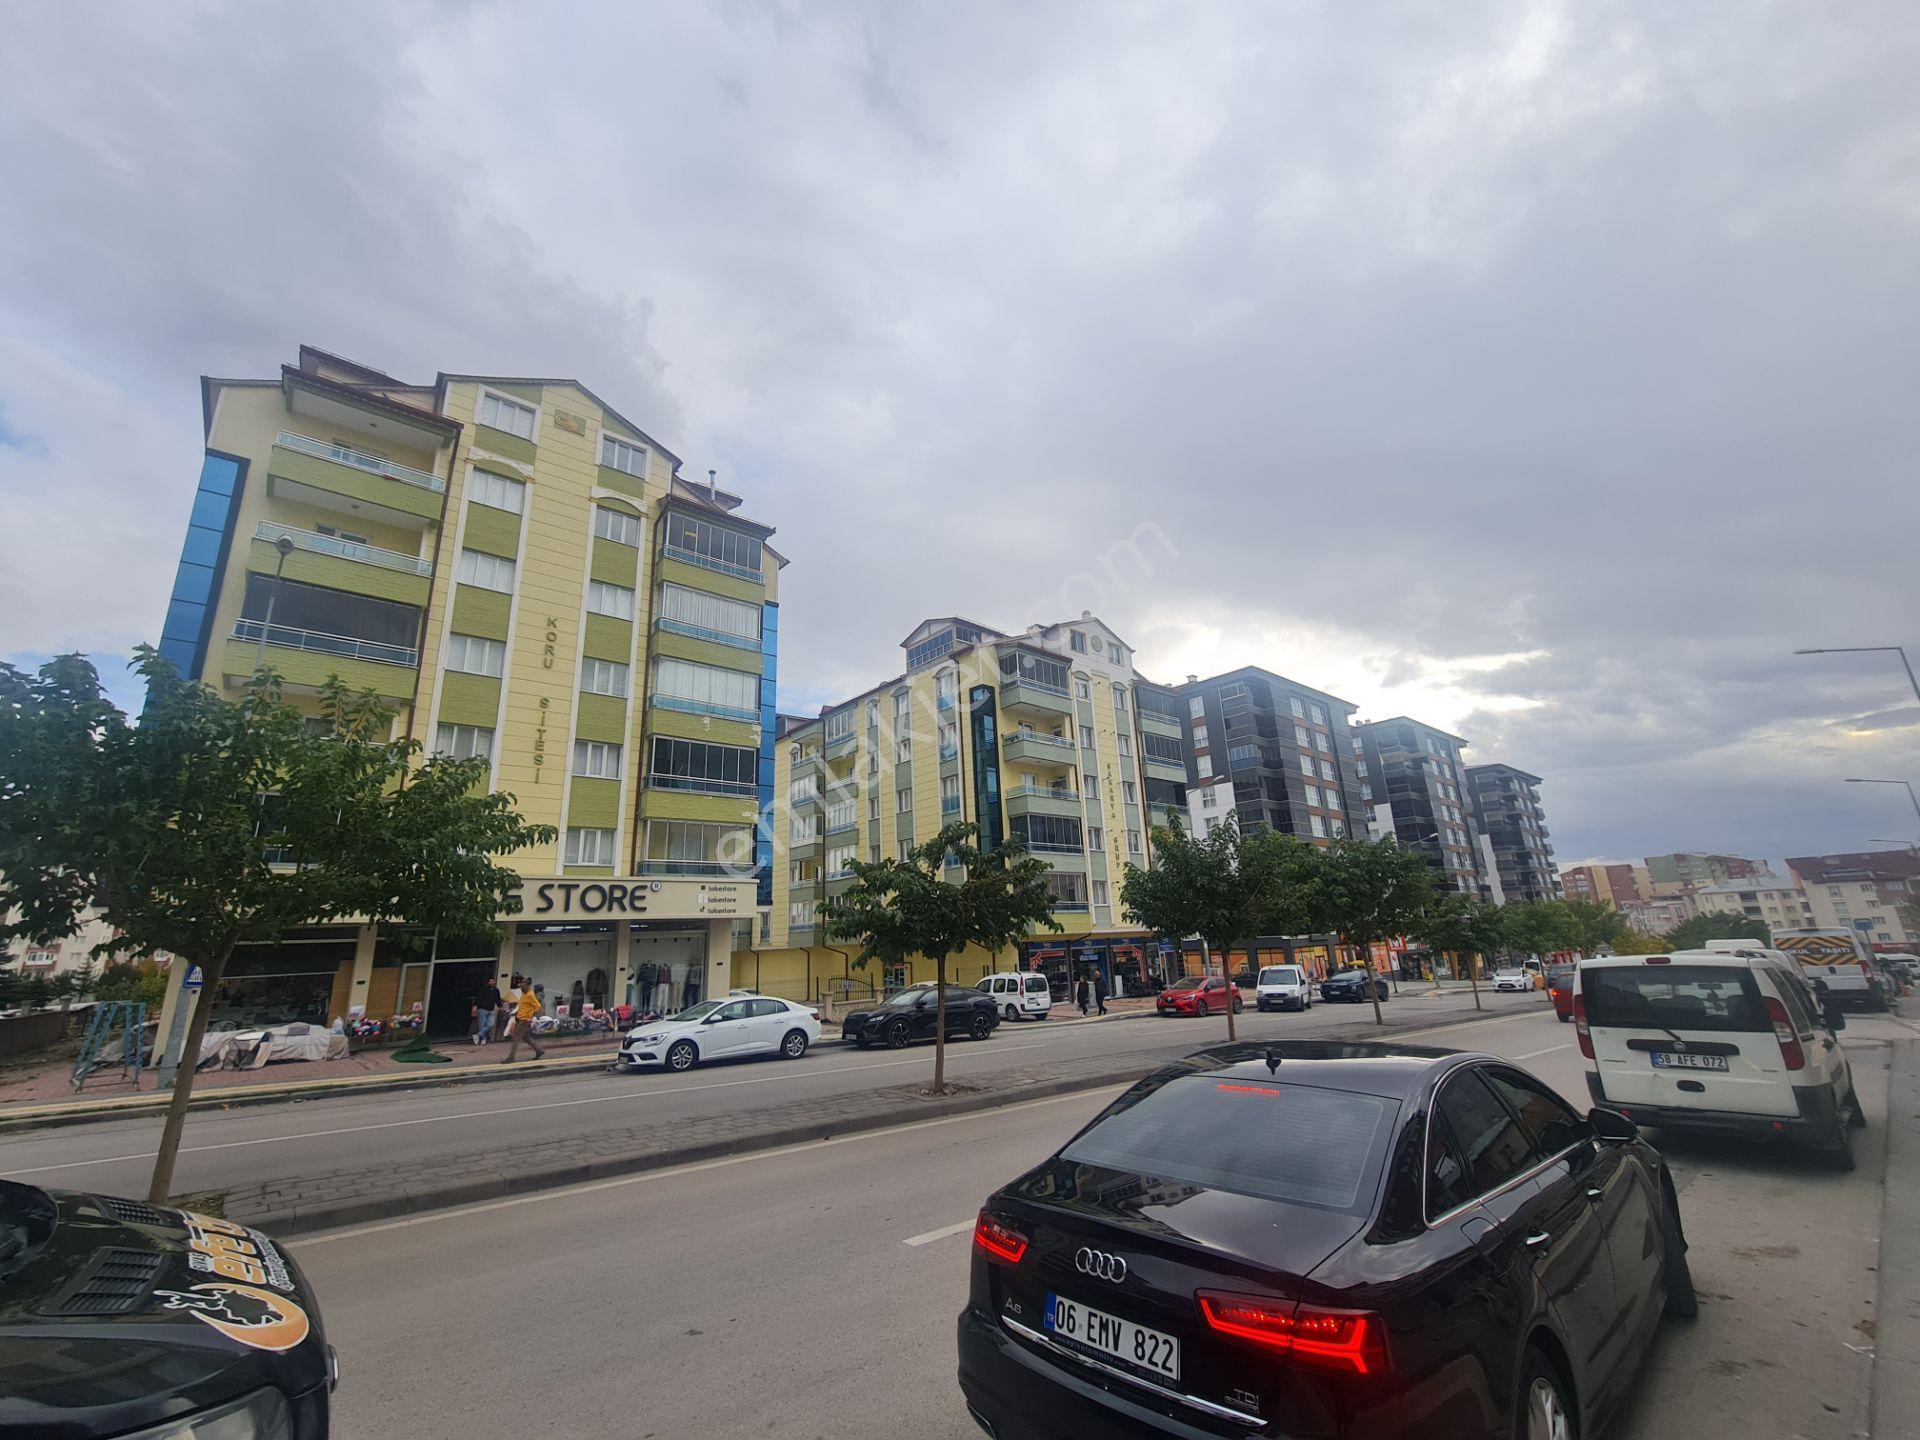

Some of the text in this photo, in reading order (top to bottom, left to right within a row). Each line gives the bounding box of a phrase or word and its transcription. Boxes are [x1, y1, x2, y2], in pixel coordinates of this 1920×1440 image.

[543, 617, 557, 669] KORU
[536, 884, 648, 913] STORE
[1658, 1053, 1725, 1068] 58 AFE 072
[1005, 1296, 1022, 1314] A6
[1056, 1300, 1076, 1334] 06
[1087, 1311, 1122, 1352] EMV
[1134, 1329, 1174, 1373] 822
